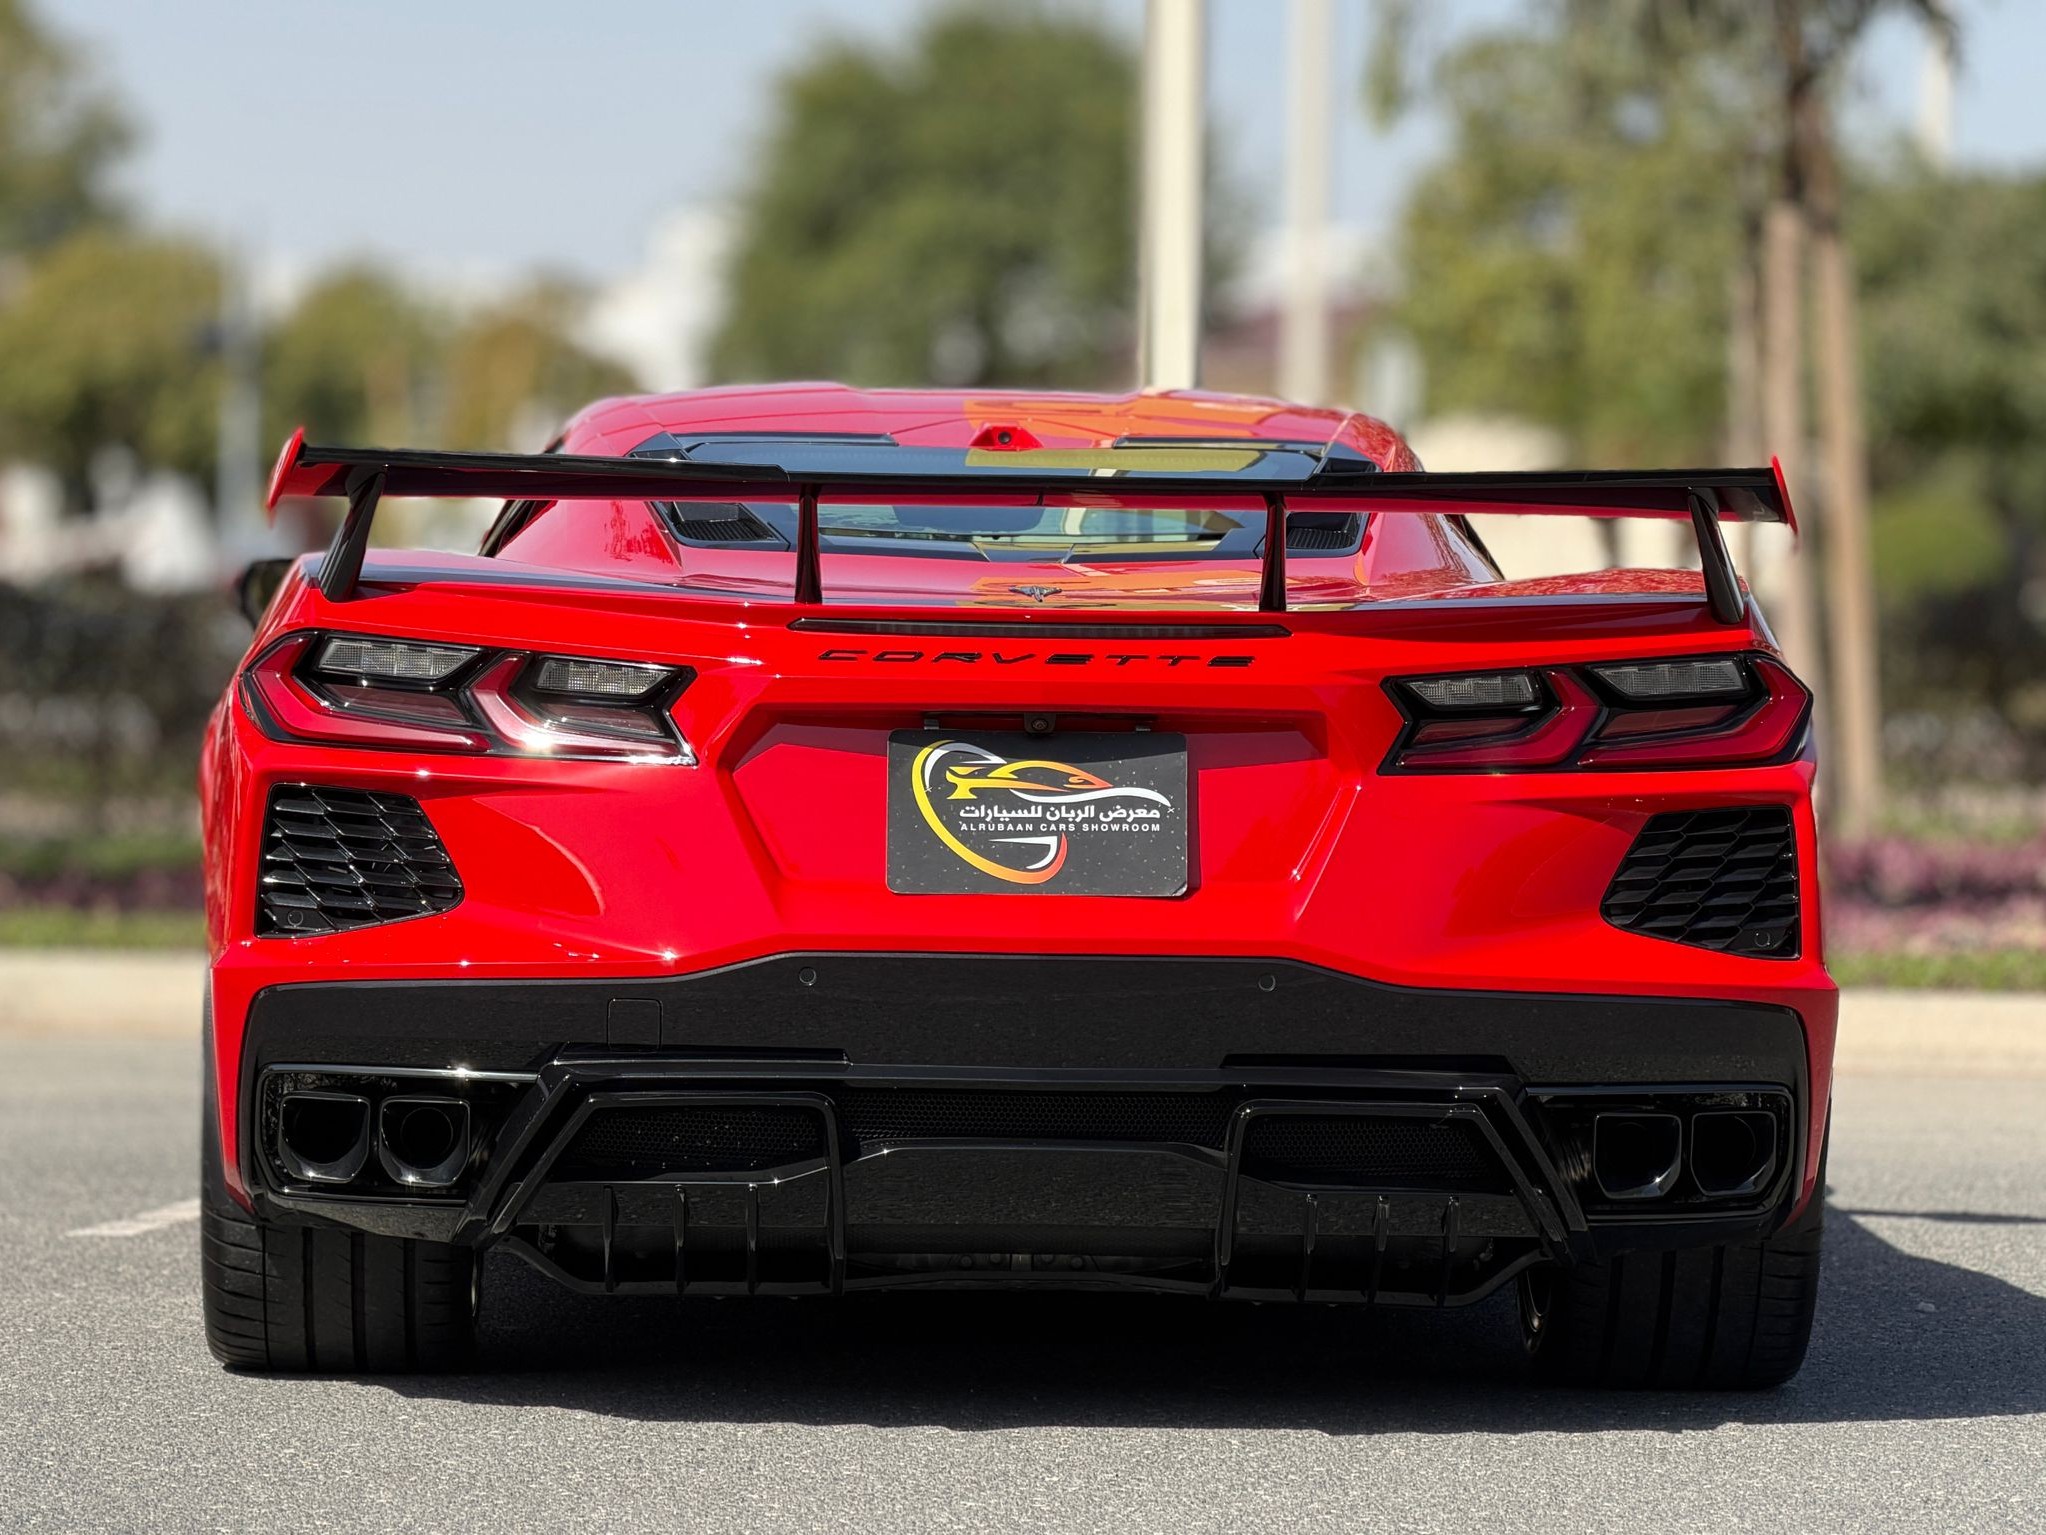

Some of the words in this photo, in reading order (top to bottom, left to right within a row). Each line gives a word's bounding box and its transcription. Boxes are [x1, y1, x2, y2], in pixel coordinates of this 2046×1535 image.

[817, 648, 1256, 668] CORVETTE
[959, 804, 1043, 822] للسيارات
[1046, 804, 1095, 822] الربان
[1099, 804, 1161, 822] معرض
[960, 822, 1034, 832] ALRUBAAN
[1039, 822, 1076, 832] CARS
[1082, 822, 1161, 832] SHOWROOM
